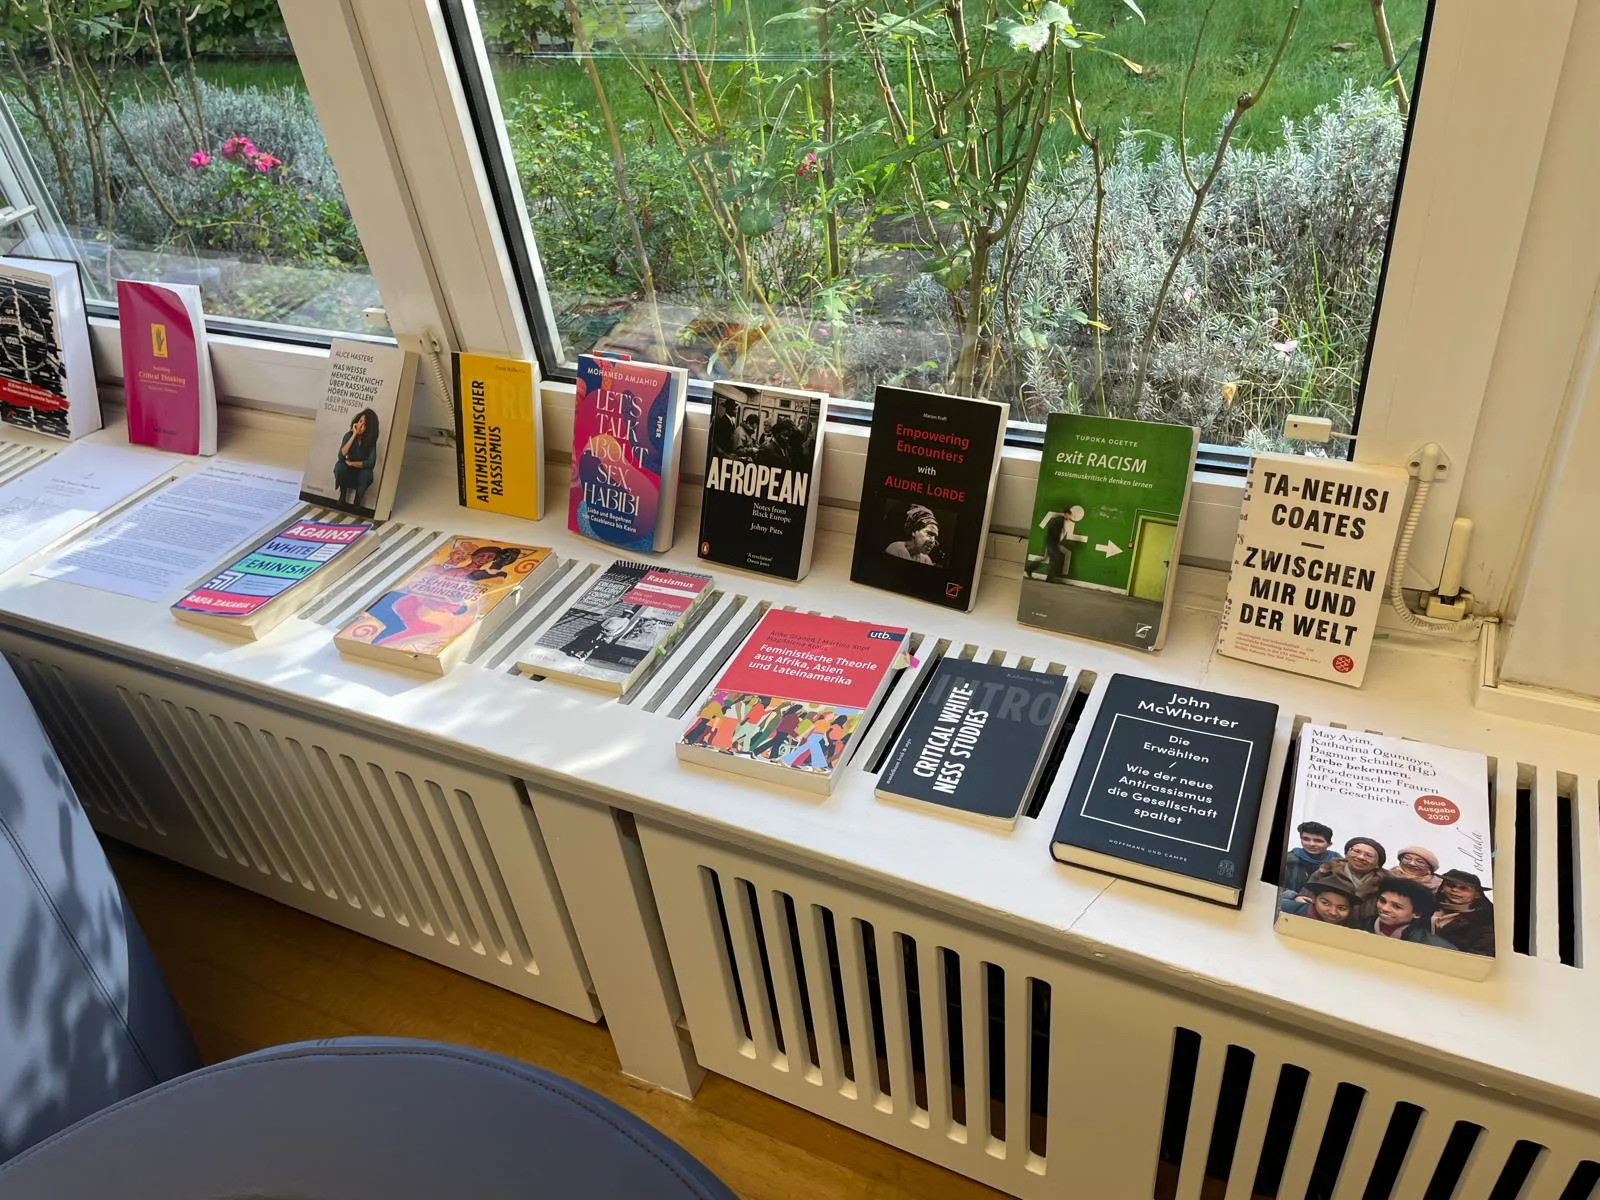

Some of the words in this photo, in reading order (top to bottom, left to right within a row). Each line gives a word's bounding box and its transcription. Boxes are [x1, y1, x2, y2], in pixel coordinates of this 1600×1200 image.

[351, 353, 374, 363] HASTERS
[139, 371, 159, 380] Critical
[161, 374, 186, 385] Thinking
[331, 372, 364, 383] MENSCHEN
[365, 377, 384, 386] NICHT
[346, 365, 367, 375] WEISSE
[587, 367, 624, 380] MOHAMED
[625, 375, 658, 387] AMJAHID
[345, 382, 378, 394] RASSISMUS
[350, 391, 374, 402] WOLLEN
[324, 403, 349, 414] SOLLTEN
[342, 399, 363, 408] WISSEN
[596, 413, 640, 443] TALK
[896, 424, 970, 451] Empowering
[472, 380, 489, 503] ANTIMUSLIMISCHER
[896, 440, 964, 464] Encounters
[1076, 434, 1106, 444] TUPOKA
[1109, 439, 1138, 448] OGETTE
[489, 426, 503, 496] RASSISMUS
[584, 436, 649, 469] ABOUT
[1056, 451, 1084, 465] exit
[1086, 453, 1147, 474] RACISM
[597, 463, 632, 493] SEX,
[706, 456, 808, 507] AFROPEAN
[918, 466, 937, 477] with
[1054, 470, 1107, 483] rassismuskritisch
[1109, 477, 1131, 487] denken
[1132, 480, 1153, 489] lernen
[584, 482, 640, 516] HABIBI
[885, 475, 923, 494] AUDRE
[926, 484, 966, 502] LORDE
[1264, 472, 1389, 514] TA-NEHISI
[588, 507, 599, 515] Liebe
[609, 513, 632, 524] Begehren
[752, 510, 769, 519] Black
[770, 513, 791, 523] Europe
[753, 502, 771, 512] Notes
[771, 506, 787, 515] from
[591, 515, 615, 527] Casablanca
[624, 524, 637, 533] Kairo
[750, 523, 769, 533] Johny
[770, 526, 783, 535] Pitts
[1272, 503, 1366, 540] COATES
[287, 526, 362, 541] AGAINST
[266, 541, 317, 555] WHITE
[1243, 546, 1376, 592] ZWISCHEN
[412, 584, 480, 601] FEMINISMUS
[420, 577, 489, 594] SCHWARZER
[647, 575, 695, 589] Rassismus
[186, 595, 212, 605] RAFIA
[1250, 576, 1296, 606] MIR
[1304, 587, 1356, 618] UND
[870, 630, 891, 640] utb.
[1239, 603, 1284, 632] DER
[1293, 614, 1358, 647] WELT
[754, 653, 773, 662] aus
[775, 656, 809, 671] Afrika,
[812, 663, 844, 675] Asien
[760, 644, 833, 664] Feministische
[836, 657, 878, 671] Theorie
[749, 662, 771, 671] und
[773, 666, 853, 686] Lateinamerika
[1168, 693, 1211, 710] John
[1137, 700, 1240, 729] McWhorter
[913, 726, 956, 778] CRITICAL
[938, 682, 974, 724] WHITE-
[1169, 735, 1191, 746] Die
[1312, 729, 1335, 741] May
[933, 762, 966, 794] NESS
[950, 709, 989, 759] STUDIES
[1144, 742, 1210, 763] Erwählten
[1310, 746, 1357, 762] Dagmar
[1360, 756, 1406, 769] Schultz
[1408, 764, 1437, 777] (Hg.)
[1311, 738, 1369, 755] Katharina
[1373, 748, 1433, 768] Oguntoye,
[1126, 764, 1150, 777] Wie
[1154, 771, 1177, 782] der
[1180, 777, 1214, 791] neue
[1309, 755, 1343, 767] Farbe
[1346, 762, 1411, 779] bekennen.
[1118, 775, 1213, 804] Antirassismus
[1307, 773, 1328, 783] auf
[1330, 777, 1353, 787] den
[1356, 782, 1401, 797] Spuren
[1308, 764, 1392, 785] Afro-deutsche
[1396, 779, 1439, 794] Frauen
[1107, 787, 1129, 798] die
[1132, 792, 1218, 819] Gesellschaft
[1306, 780, 1338, 792] ihrer
[1339, 788, 1409, 807] Geschichte.
[1134, 808, 1183, 825] spaltet
[1418, 806, 1456, 814] Ausgabe
[1109, 839, 1146, 852] HOFFMANN
[1164, 853, 1188, 862] CAMPE
